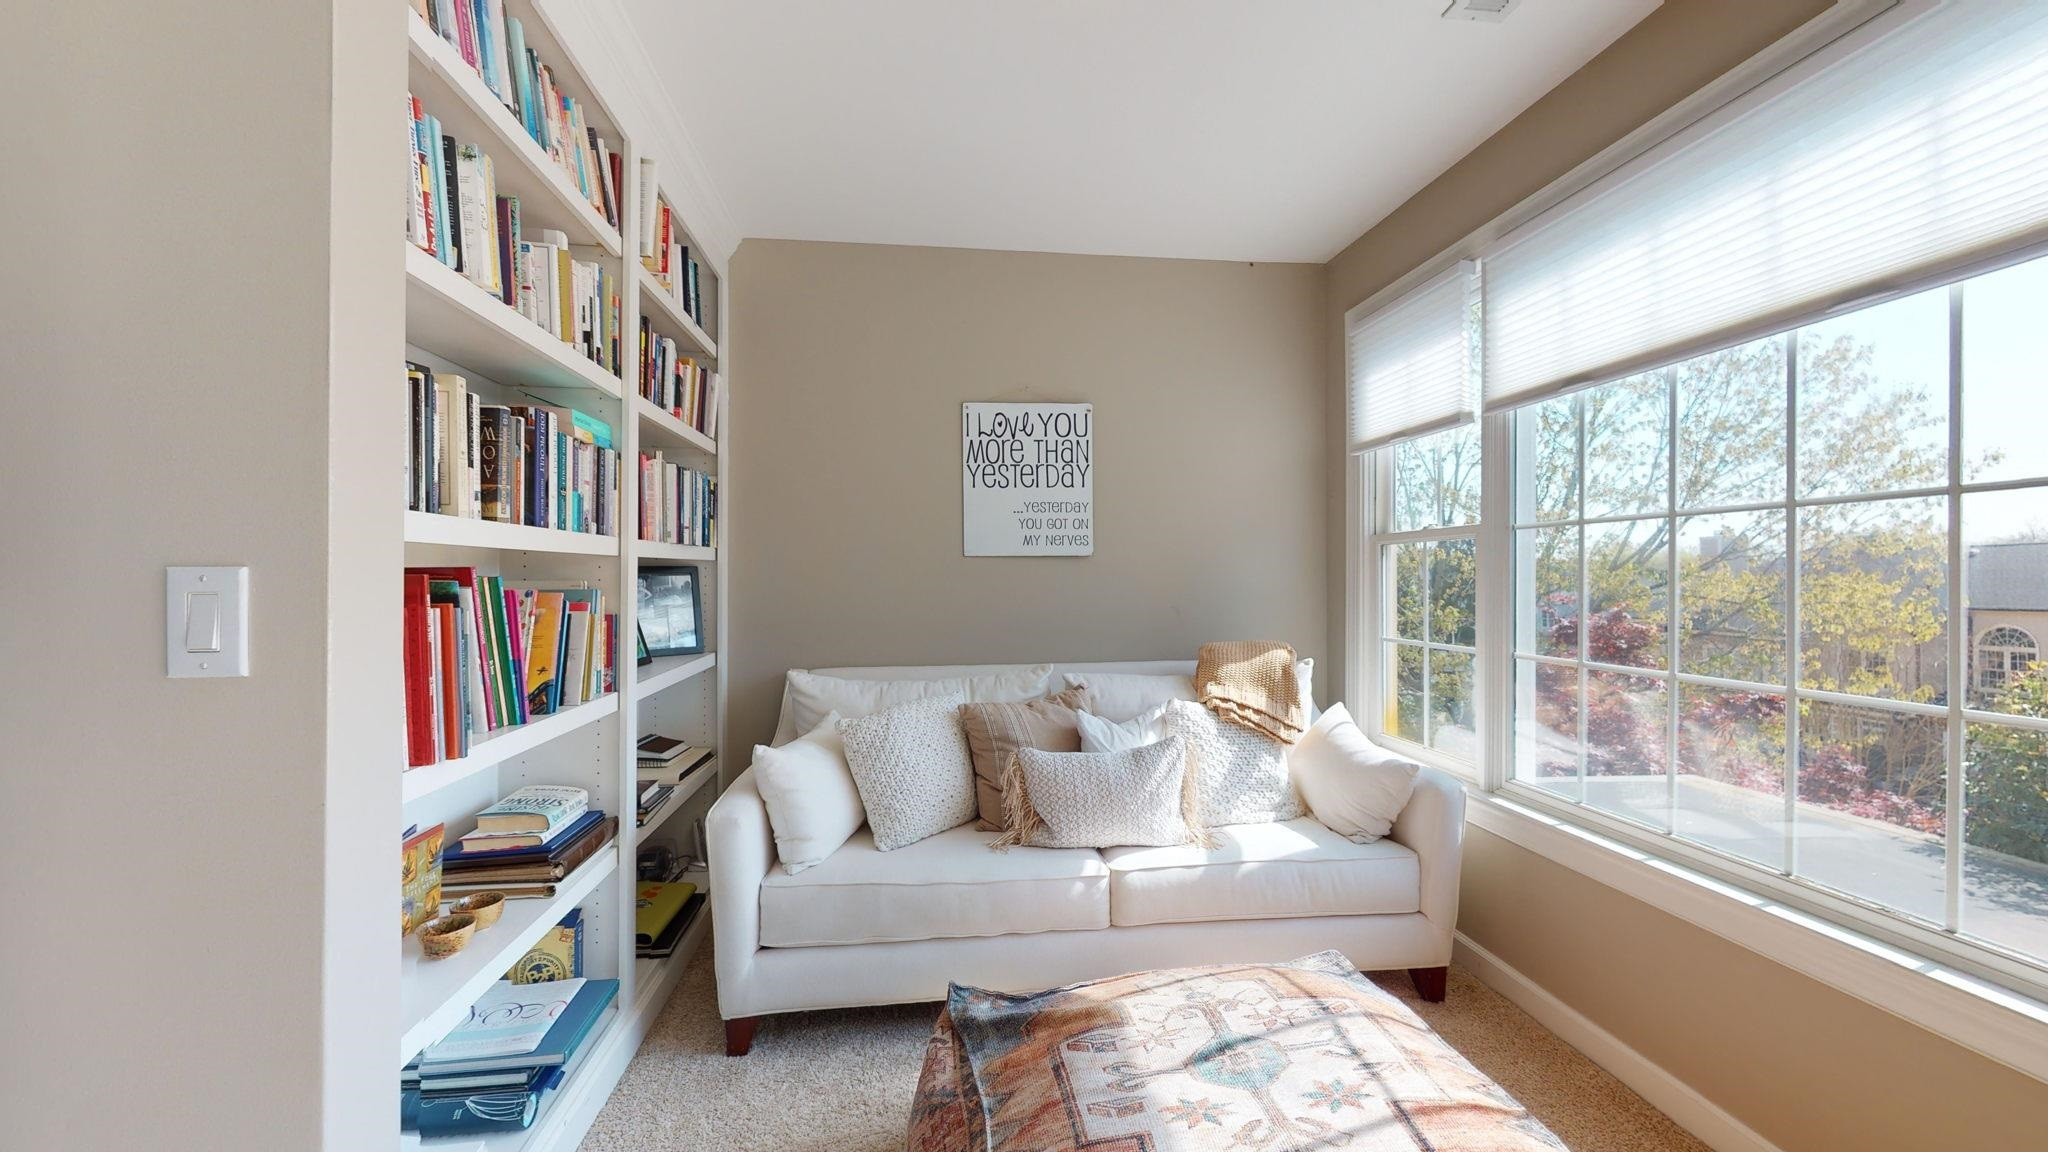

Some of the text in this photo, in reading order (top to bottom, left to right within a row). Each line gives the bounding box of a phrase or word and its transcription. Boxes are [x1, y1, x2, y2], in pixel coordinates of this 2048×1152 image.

[966, 413, 969, 437] I
[1038, 412, 1088, 437] YOU
[1018, 518, 1089, 530] YOU GOT ON
[1022, 535, 1041, 546] MY
